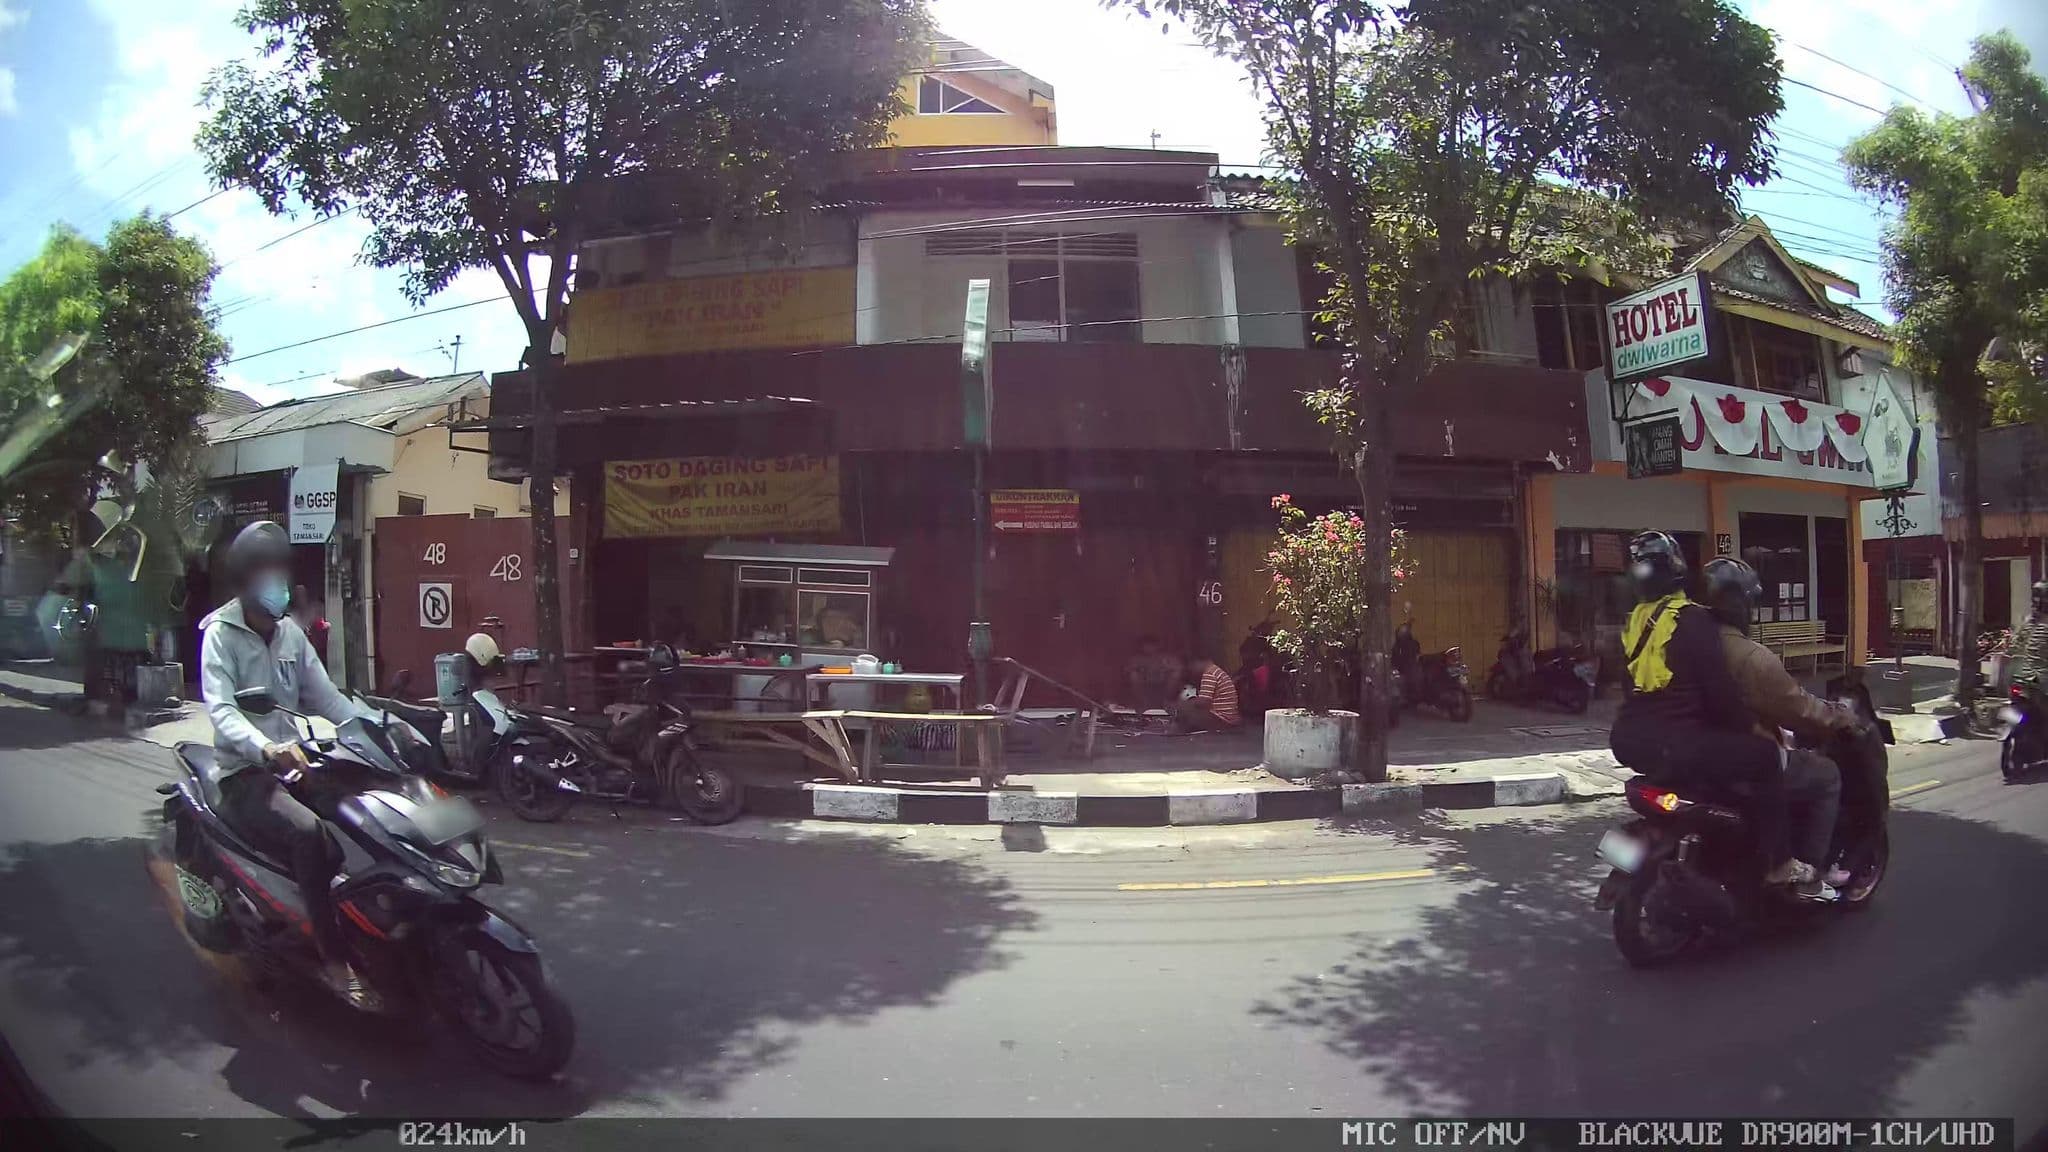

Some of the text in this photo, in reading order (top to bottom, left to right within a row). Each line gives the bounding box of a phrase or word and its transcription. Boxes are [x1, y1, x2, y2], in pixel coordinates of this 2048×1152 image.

[1612, 288, 1698, 348] HOTEL
[1617, 333, 1700, 370] dwiwarna
[614, 454, 829, 481] SOTO DAGING SAPI
[306, 491, 337, 509] GGSP
[669, 479, 768, 500] PAK IRAN
[650, 503, 788, 520] KHAS TAMANSARI
[423, 543, 447, 565] 48
[489, 554, 522, 582] 48
[1200, 581, 1222, 605] 46
